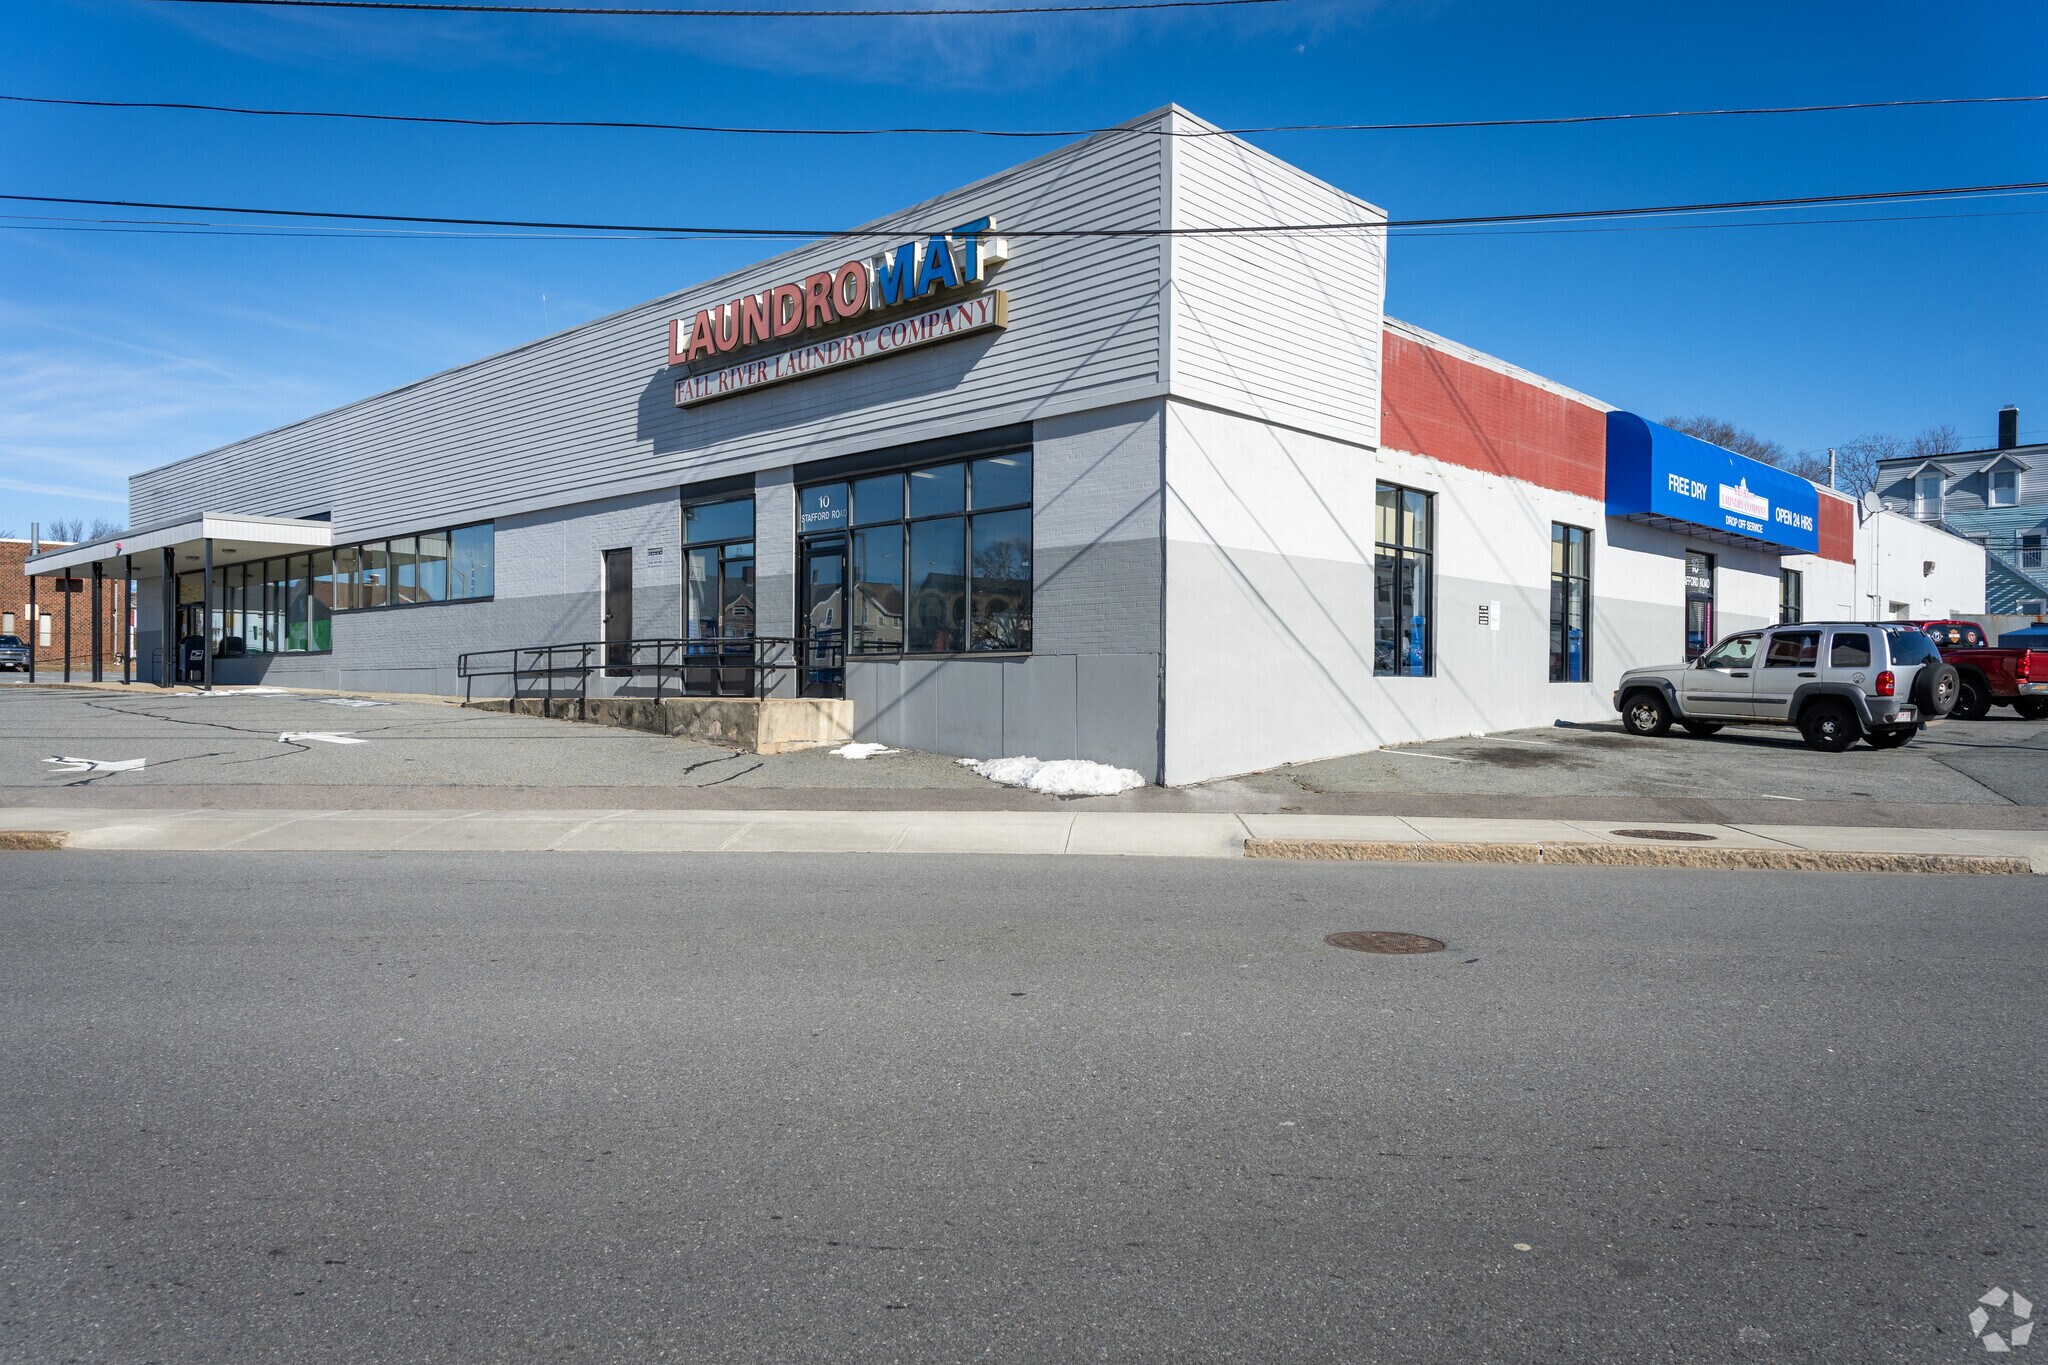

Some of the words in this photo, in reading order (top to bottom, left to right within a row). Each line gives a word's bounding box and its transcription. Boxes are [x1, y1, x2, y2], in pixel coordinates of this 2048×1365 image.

[668, 215, 997, 366] LAUNDROMAT
[676, 375, 713, 403] FALL
[718, 361, 768, 393] RIVER
[775, 331, 870, 377] LAUNDRY
[878, 297, 993, 350] COMPANY
[1668, 473, 1690, 496] FREE
[1691, 480, 1707, 501] DRY
[818, 495, 830, 508] 10
[1721, 494, 1744, 510] LAUNDRY
[1744, 501, 1766, 516] COMPANY
[801, 511, 830, 523] STAFFORD
[831, 508, 847, 519] ROAD
[1725, 515, 1738, 527] DROP
[1738, 518, 1747, 530] OFF
[1746, 520, 1763, 534] SERVICE
[1775, 506, 1792, 526] OPEN
[1793, 512, 1800, 528] 24
[1801, 514, 1813, 532] HRS
[1699, 577, 1711, 589] ROAD
